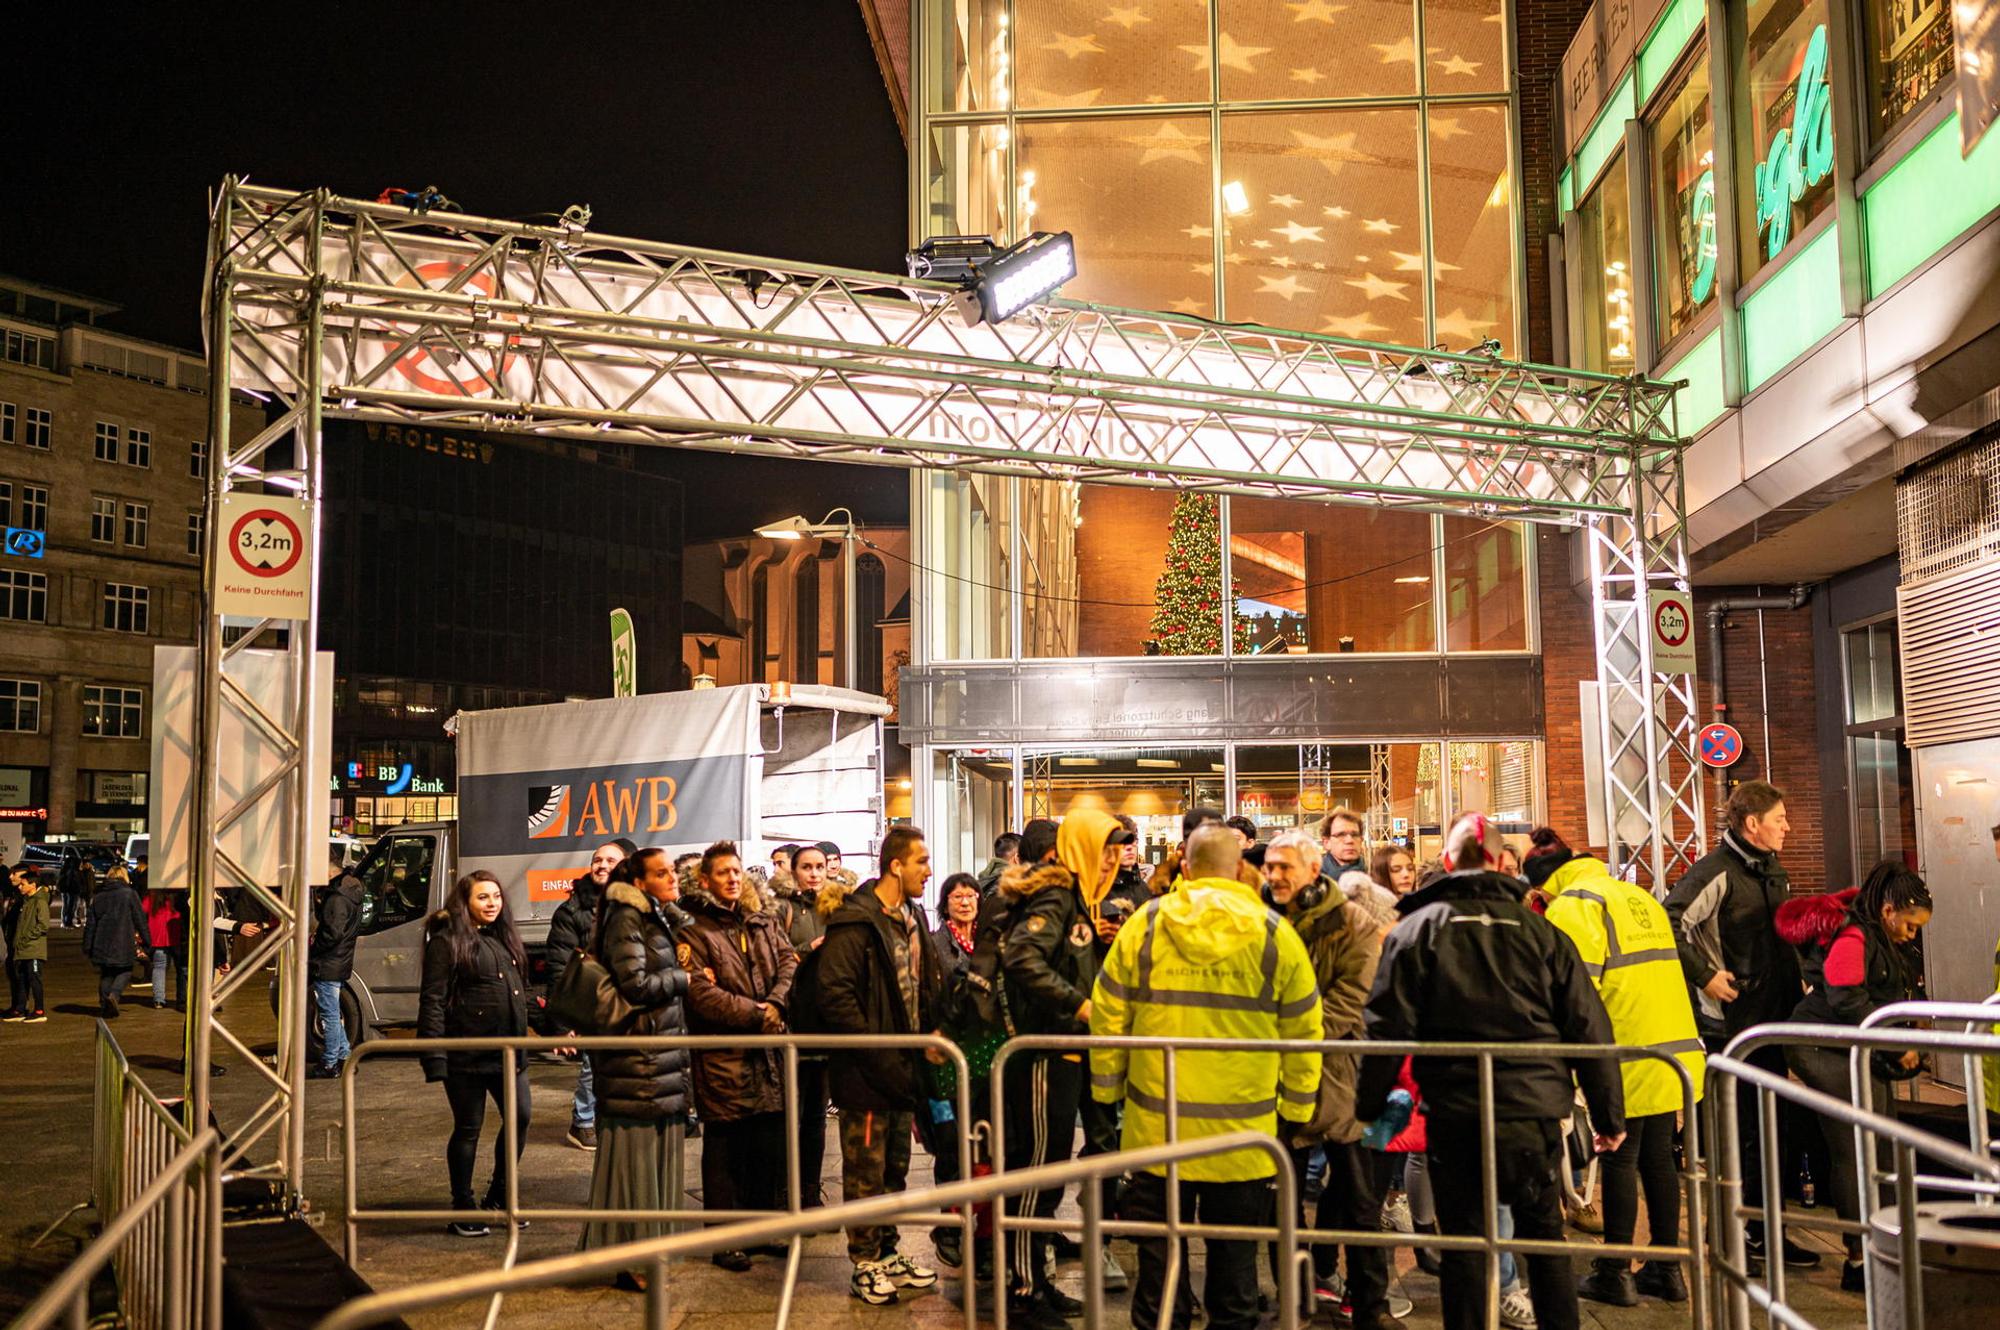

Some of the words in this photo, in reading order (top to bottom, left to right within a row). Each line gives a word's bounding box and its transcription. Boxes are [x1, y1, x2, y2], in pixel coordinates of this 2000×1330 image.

[1771, 86, 1795, 117] CHANEL
[385, 424, 477, 460] ROLEX
[241, 531, 291, 551] 3,2m
[224, 584, 251, 594] Keine
[254, 587, 304, 598] Durchfahrt
[1661, 615, 1684, 628] 3,2m
[379, 766, 398, 780] BB
[411, 778, 444, 792] Bank
[575, 776, 678, 836] AWB
[542, 879, 574, 891] EINFAC
